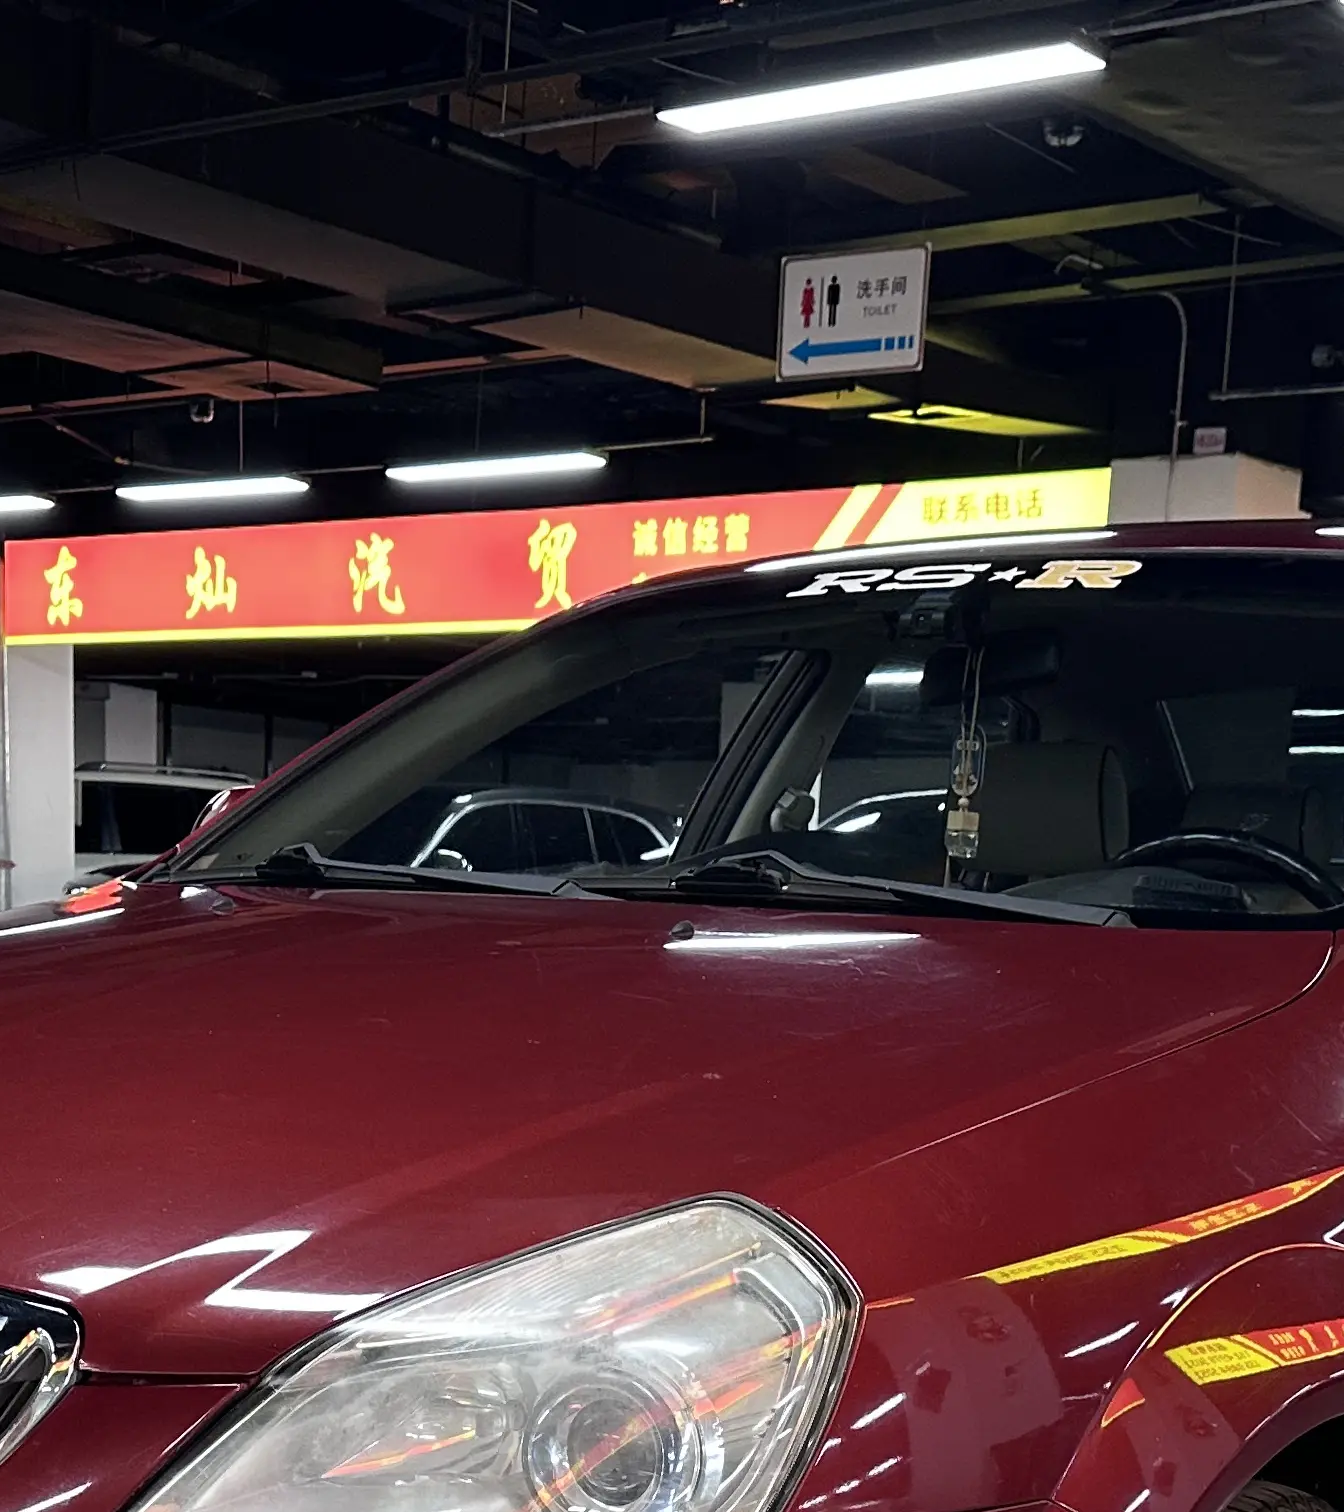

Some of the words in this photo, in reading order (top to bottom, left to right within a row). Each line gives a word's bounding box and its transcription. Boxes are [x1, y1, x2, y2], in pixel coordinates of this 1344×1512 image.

[856, 275, 908, 300] 洗手间
[863, 303, 898, 318] TOILET
[922, 487, 1046, 526] 联系电话
[632, 512, 751, 557] 诚信经营
[43, 517, 578, 627] 东灿汽贸
